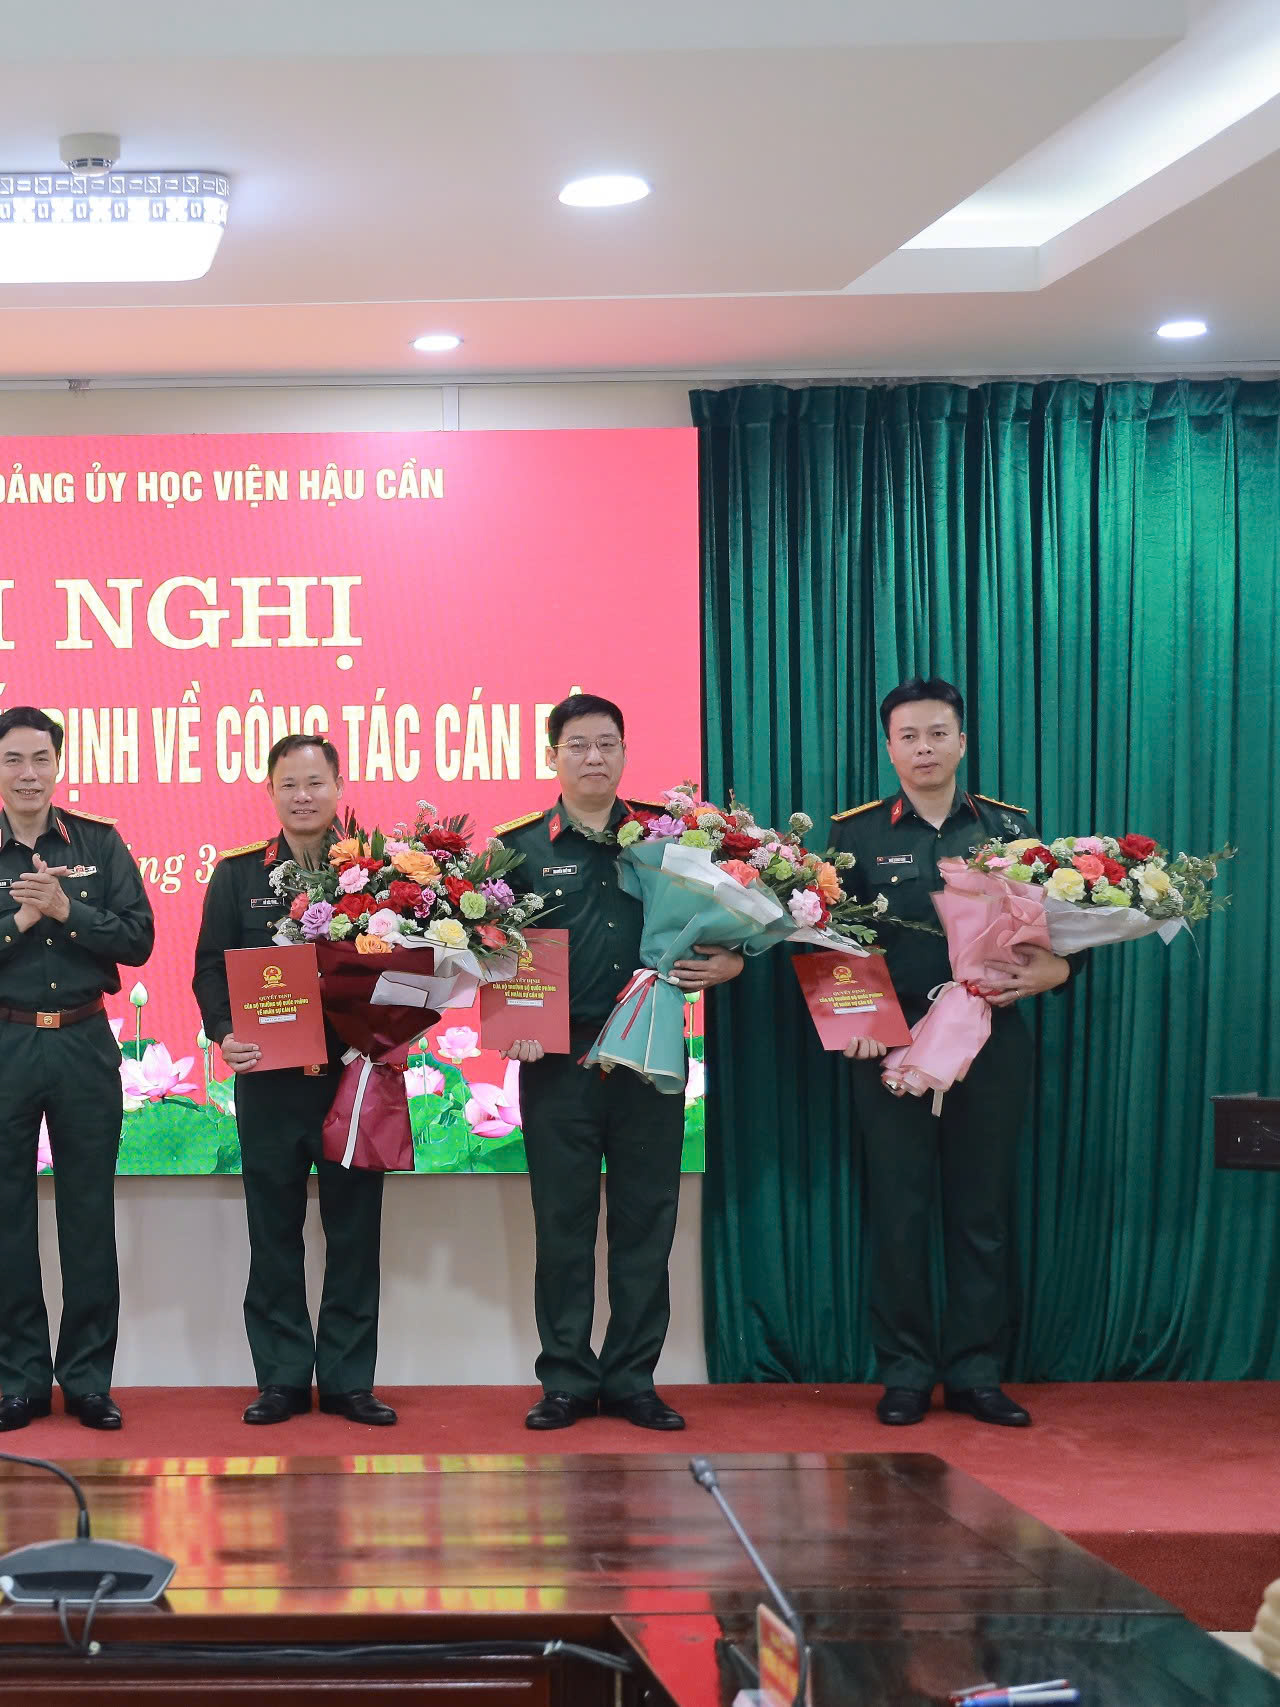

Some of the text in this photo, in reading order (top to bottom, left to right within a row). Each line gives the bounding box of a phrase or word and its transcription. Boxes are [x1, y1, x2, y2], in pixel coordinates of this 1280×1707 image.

[85, 461, 127, 503] ỦY
[137, 470, 203, 509] HỌC
[213, 463, 289, 508] VIỆN
[299, 462, 365, 507] HẬU
[375, 457, 444, 500] CẦN
[55, 575, 363, 671] NGHỊ
[151, 680, 202, 783] VỀ
[341, 687, 420, 782] TÁC
[435, 686, 521, 782] CÁN
